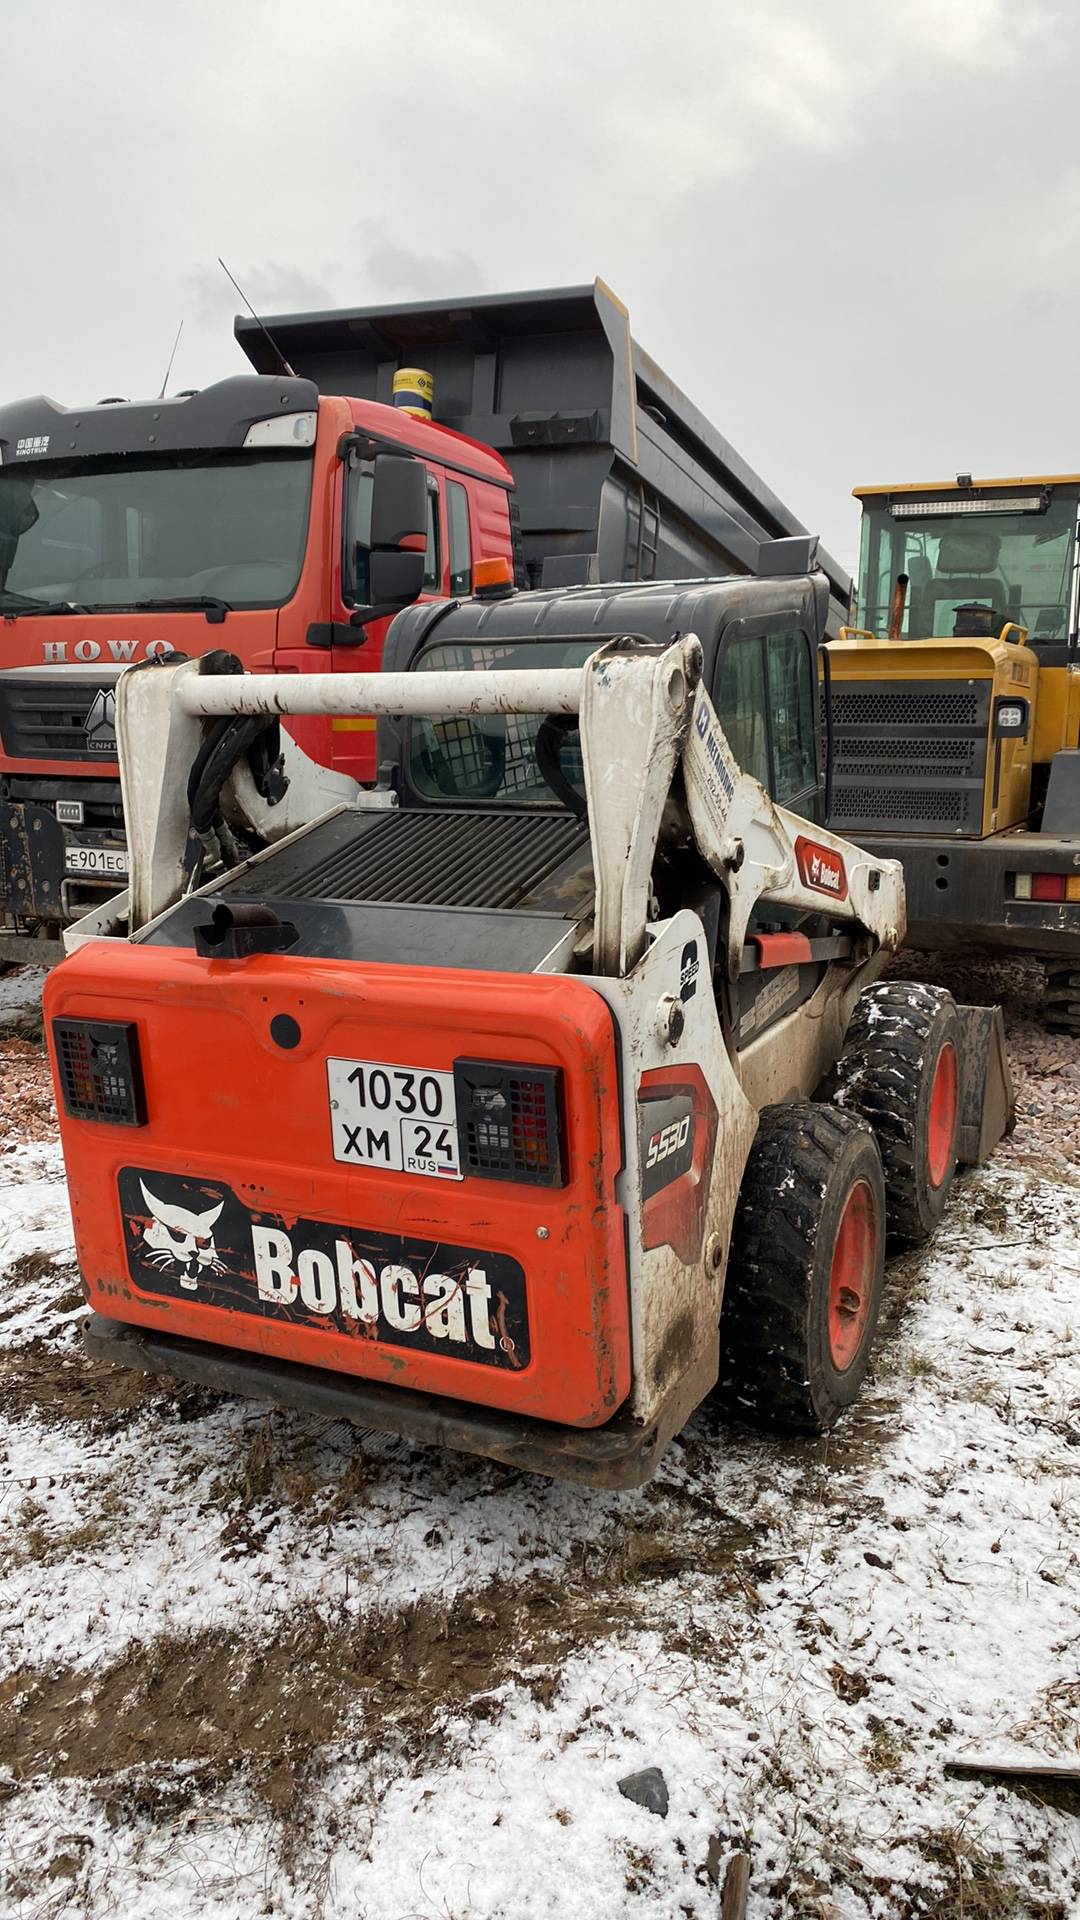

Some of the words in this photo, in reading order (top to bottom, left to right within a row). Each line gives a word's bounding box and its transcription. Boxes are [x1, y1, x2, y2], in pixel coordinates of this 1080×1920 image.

[16, 447, 48, 456] SINOTRUK
[43, 640, 175, 662] HOWO
[70, 851, 124, 869] Е901ЕС
[820, 862, 840, 889] Bobcat
[680, 960, 699, 985] SPEED
[347, 1067, 442, 1117] 1030
[342, 1123, 390, 1161] ХМ
[414, 1126, 452, 1161] 24
[646, 1115, 690, 1168] S530
[408, 1158, 436, 1172] RUS
[251, 1225, 495, 1349] Bobcat
